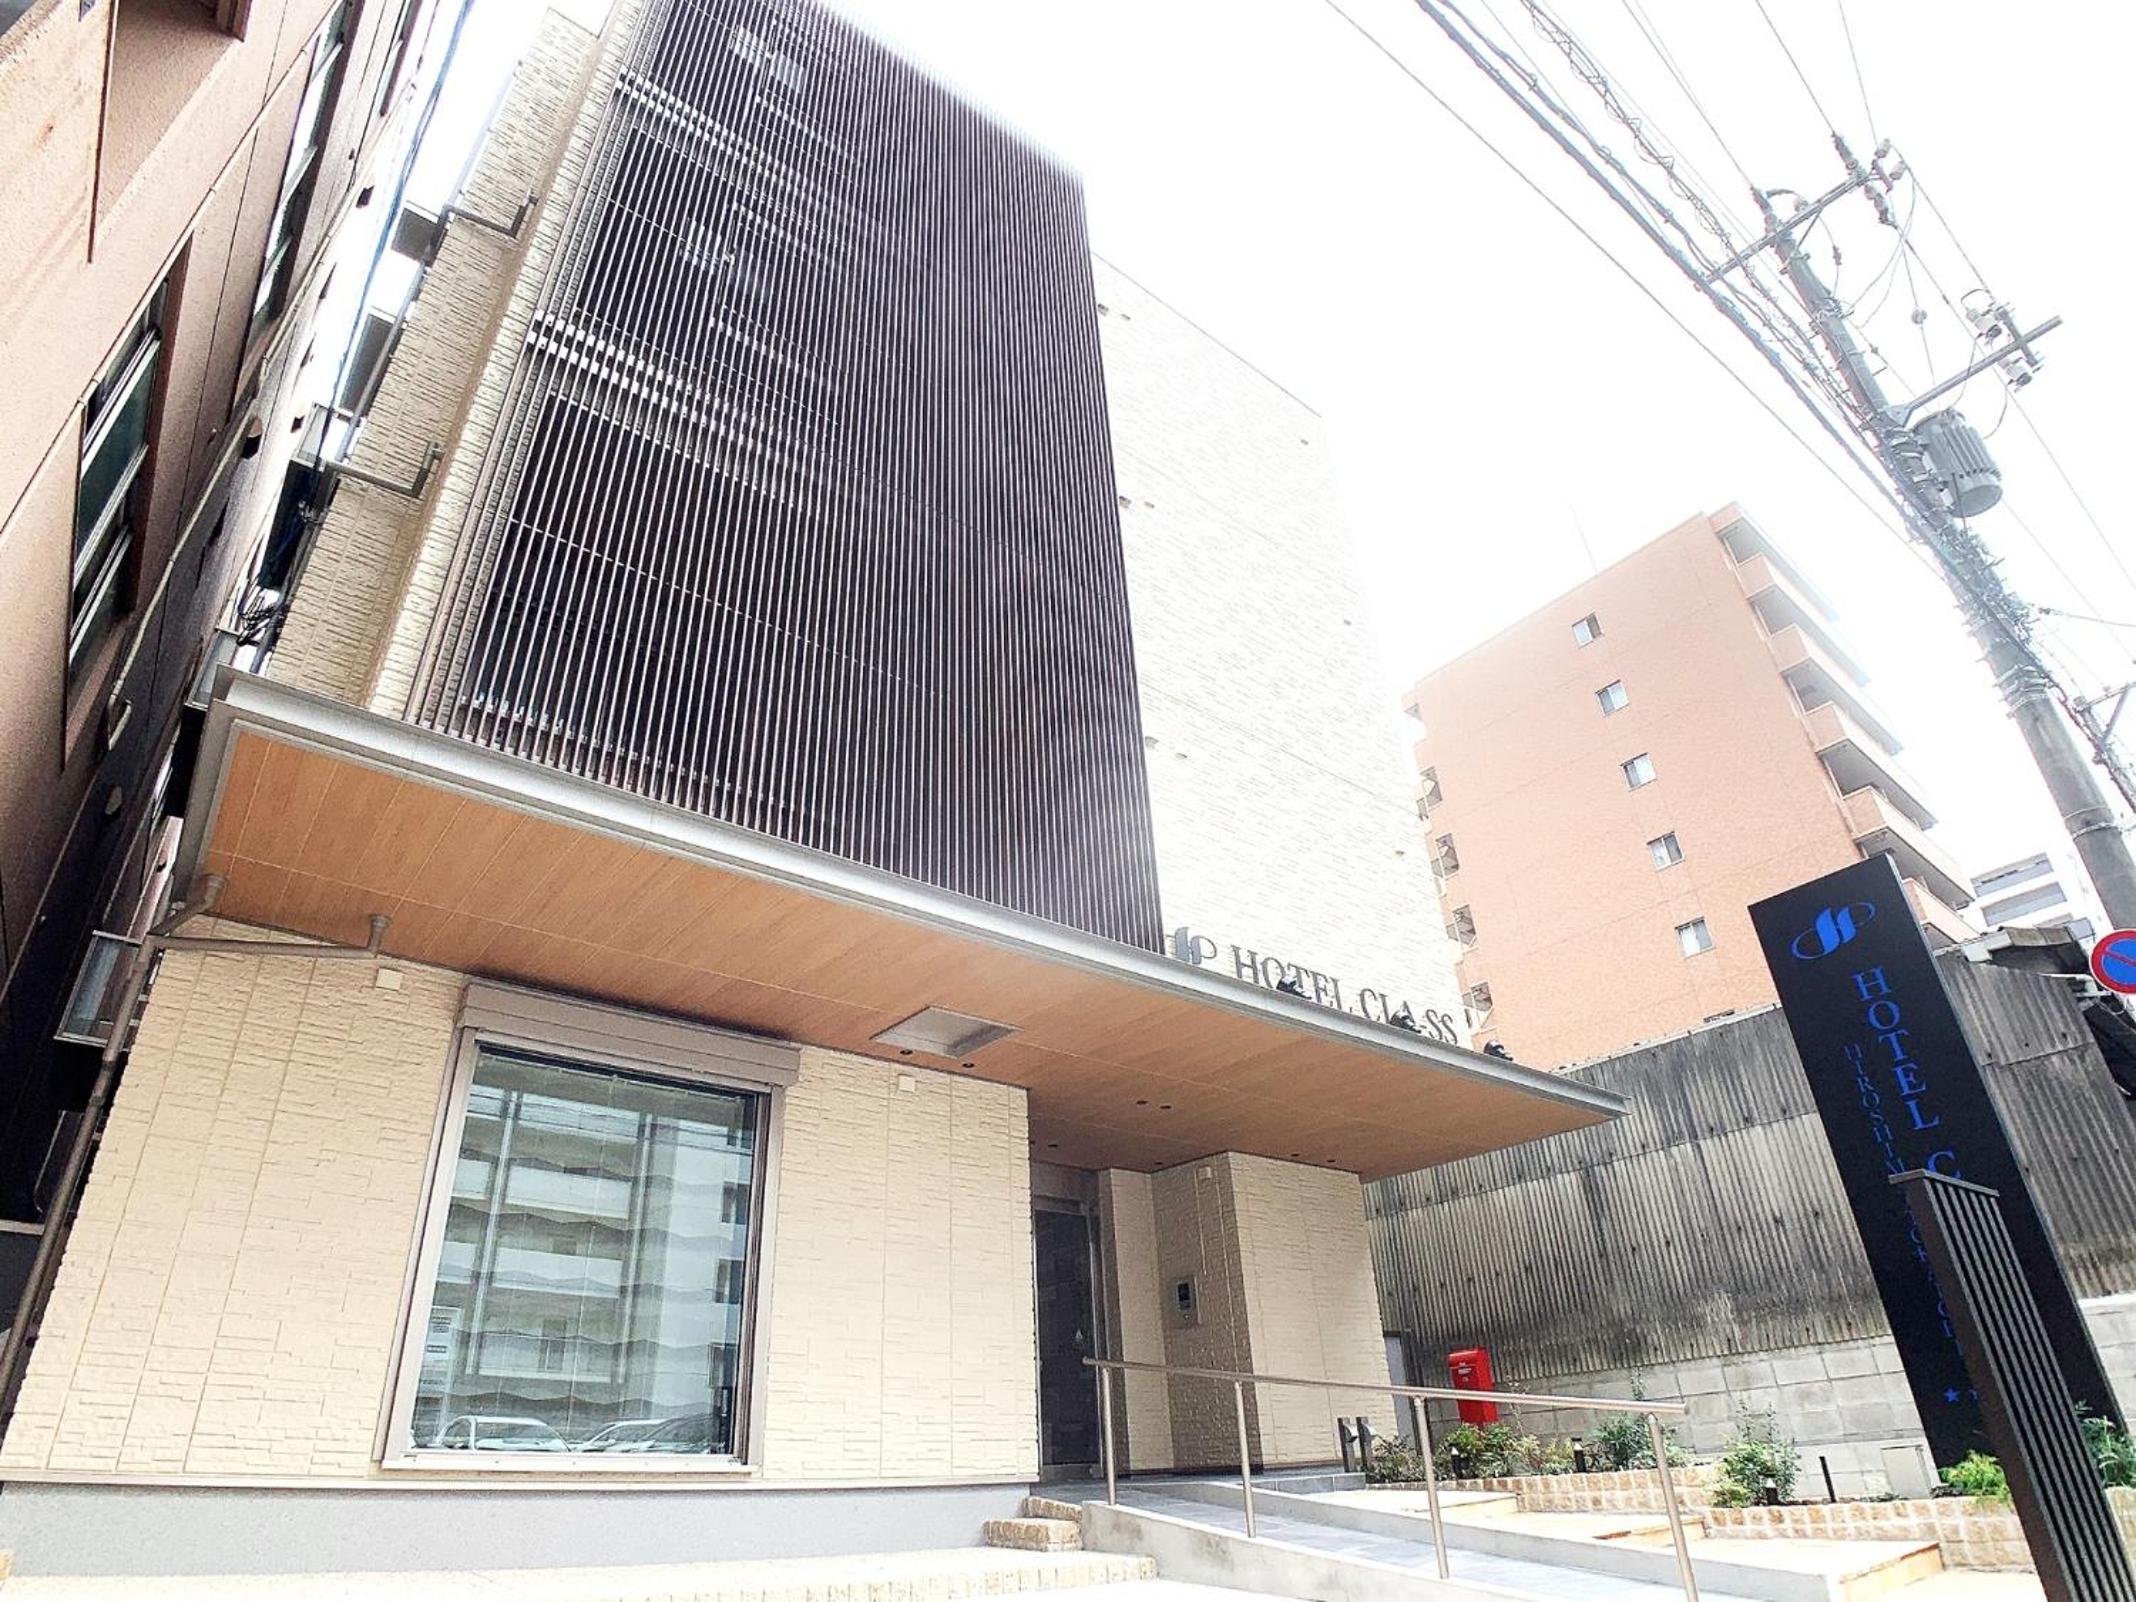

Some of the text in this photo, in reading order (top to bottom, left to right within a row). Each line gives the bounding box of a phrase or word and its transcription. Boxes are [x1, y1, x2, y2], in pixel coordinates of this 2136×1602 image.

[1230, 943, 1352, 1012] HOTEL
[1843, 1043, 1906, 1175] HIROSHIM
[1851, 965, 1941, 1131] HOTEL
